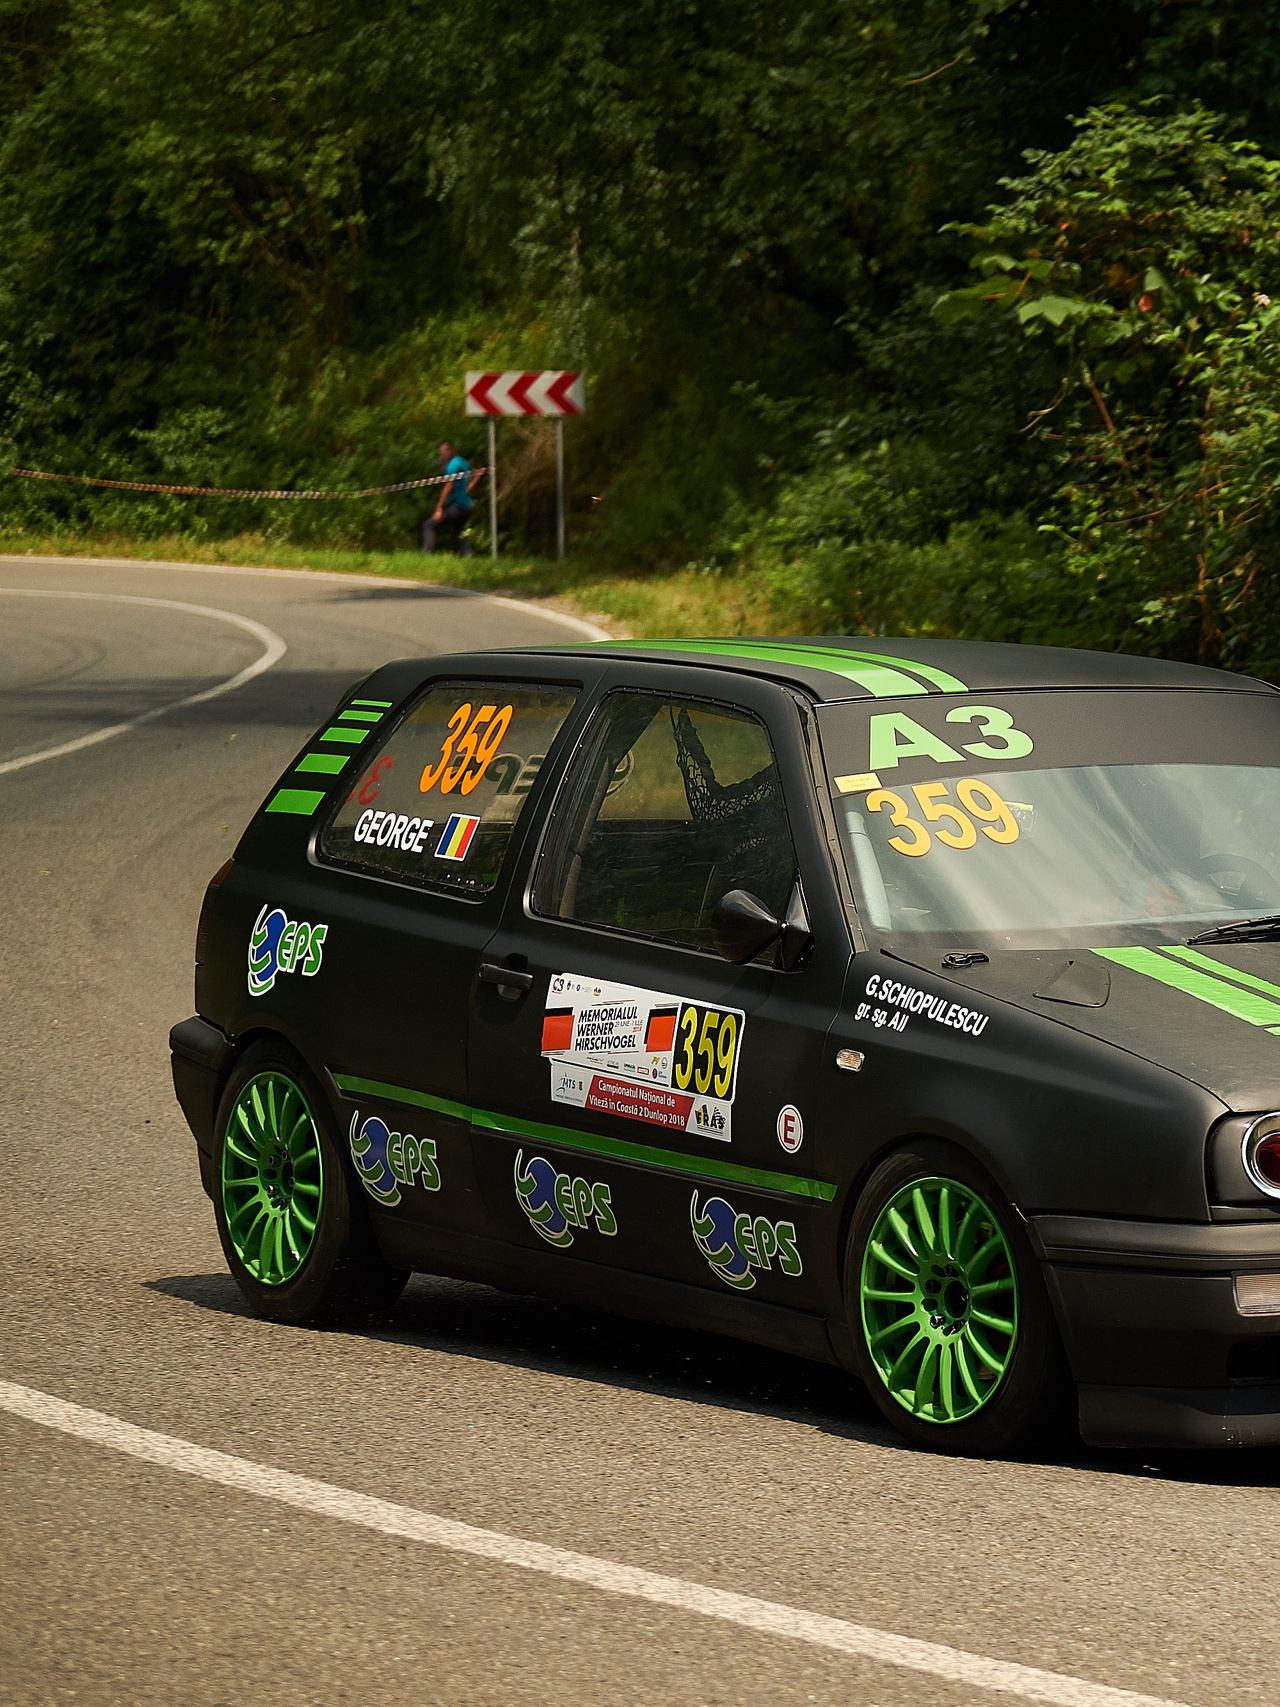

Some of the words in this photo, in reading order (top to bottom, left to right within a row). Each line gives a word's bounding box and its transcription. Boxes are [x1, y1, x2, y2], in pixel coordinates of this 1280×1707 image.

[419, 702, 514, 796] 359
[868, 705, 1034, 771] A3
[353, 808, 435, 853] GEORGE
[866, 778, 1020, 857] 359
[276, 920, 329, 977] EPS
[577, 1022, 614, 1037] WERNER
[578, 1006, 638, 1023] MEMORIALUL
[854, 1002, 871, 1021] gr.
[871, 1008, 889, 1028] sg.
[865, 974, 990, 1036] G.SCHIOPULESCU
[575, 1034, 637, 1051] HIRSCHVOGEL
[675, 1006, 736, 1098] 359
[598, 1080, 638, 1099] Campionatul
[666, 1096, 676, 1108] de
[638, 1106, 643, 1116] 2
[643, 1107, 668, 1125] Dunlop
[668, 1113, 685, 1127] 2018
[783, 1113, 796, 1145] E
[386, 1132, 442, 1192] EPS
[553, 1173, 618, 1237] EPS
[733, 1213, 803, 1277] EPS
